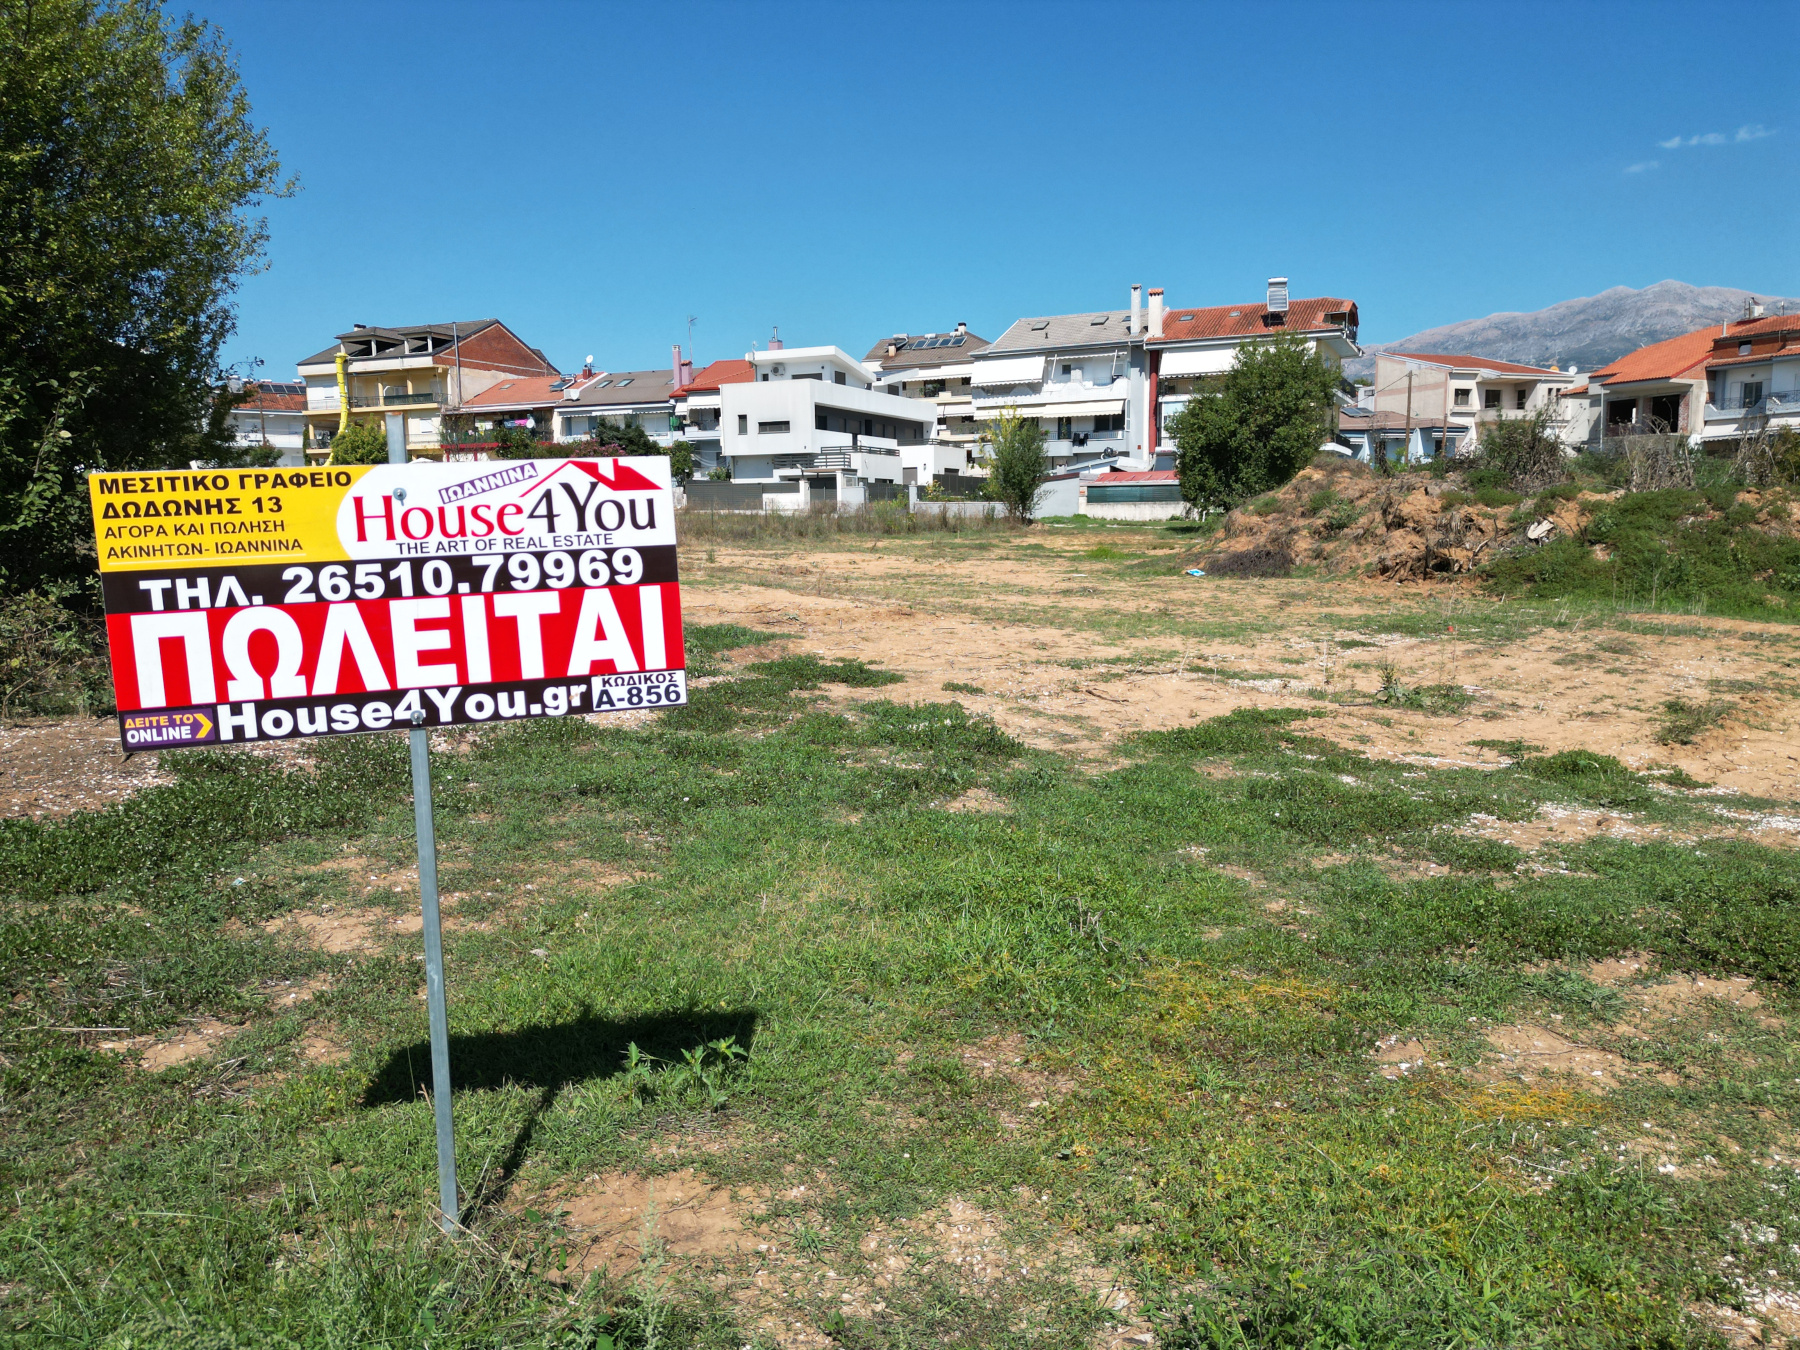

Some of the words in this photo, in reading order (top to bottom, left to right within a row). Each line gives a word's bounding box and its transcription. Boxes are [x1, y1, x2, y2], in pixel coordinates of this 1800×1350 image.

[99, 475, 230, 495] ΜΕΣΙΤΙΚΟ
[239, 471, 351, 490] ΓΡΑΦΕΙΟ
[440, 463, 538, 503] ΙΩΑΝΝΙΝΑ
[102, 498, 242, 519] ΔΩΔΩΝΗΣ
[252, 496, 283, 514] 13
[353, 481, 657, 542] House4You
[104, 523, 168, 539] ΑΓΟΡΑ
[174, 522, 204, 536] ΚΑΙ
[210, 520, 285, 535] ΠΩΛΗΣΗ
[215, 539, 303, 554] ΙΩΑΝΝΙΝΑ
[396, 541, 430, 555] THE
[435, 539, 470, 553] ART
[475, 538, 497, 552] OF
[503, 536, 548, 550] REAL
[553, 533, 614, 548] ESTATE
[139, 575, 264, 612] ΤΗΛ.
[281, 547, 643, 604] 26510.79969
[130, 585, 667, 709] ΠΩΛΕΙΤΑΙ
[601, 672, 678, 688] ΚΩΔΙΚΟΣ
[124, 715, 170, 729] ΔΕΙΤΕ
[173, 713, 194, 725] ΤΟ
[217, 683, 587, 741] House4You.gr
[126, 726, 192, 743] ONLINE
